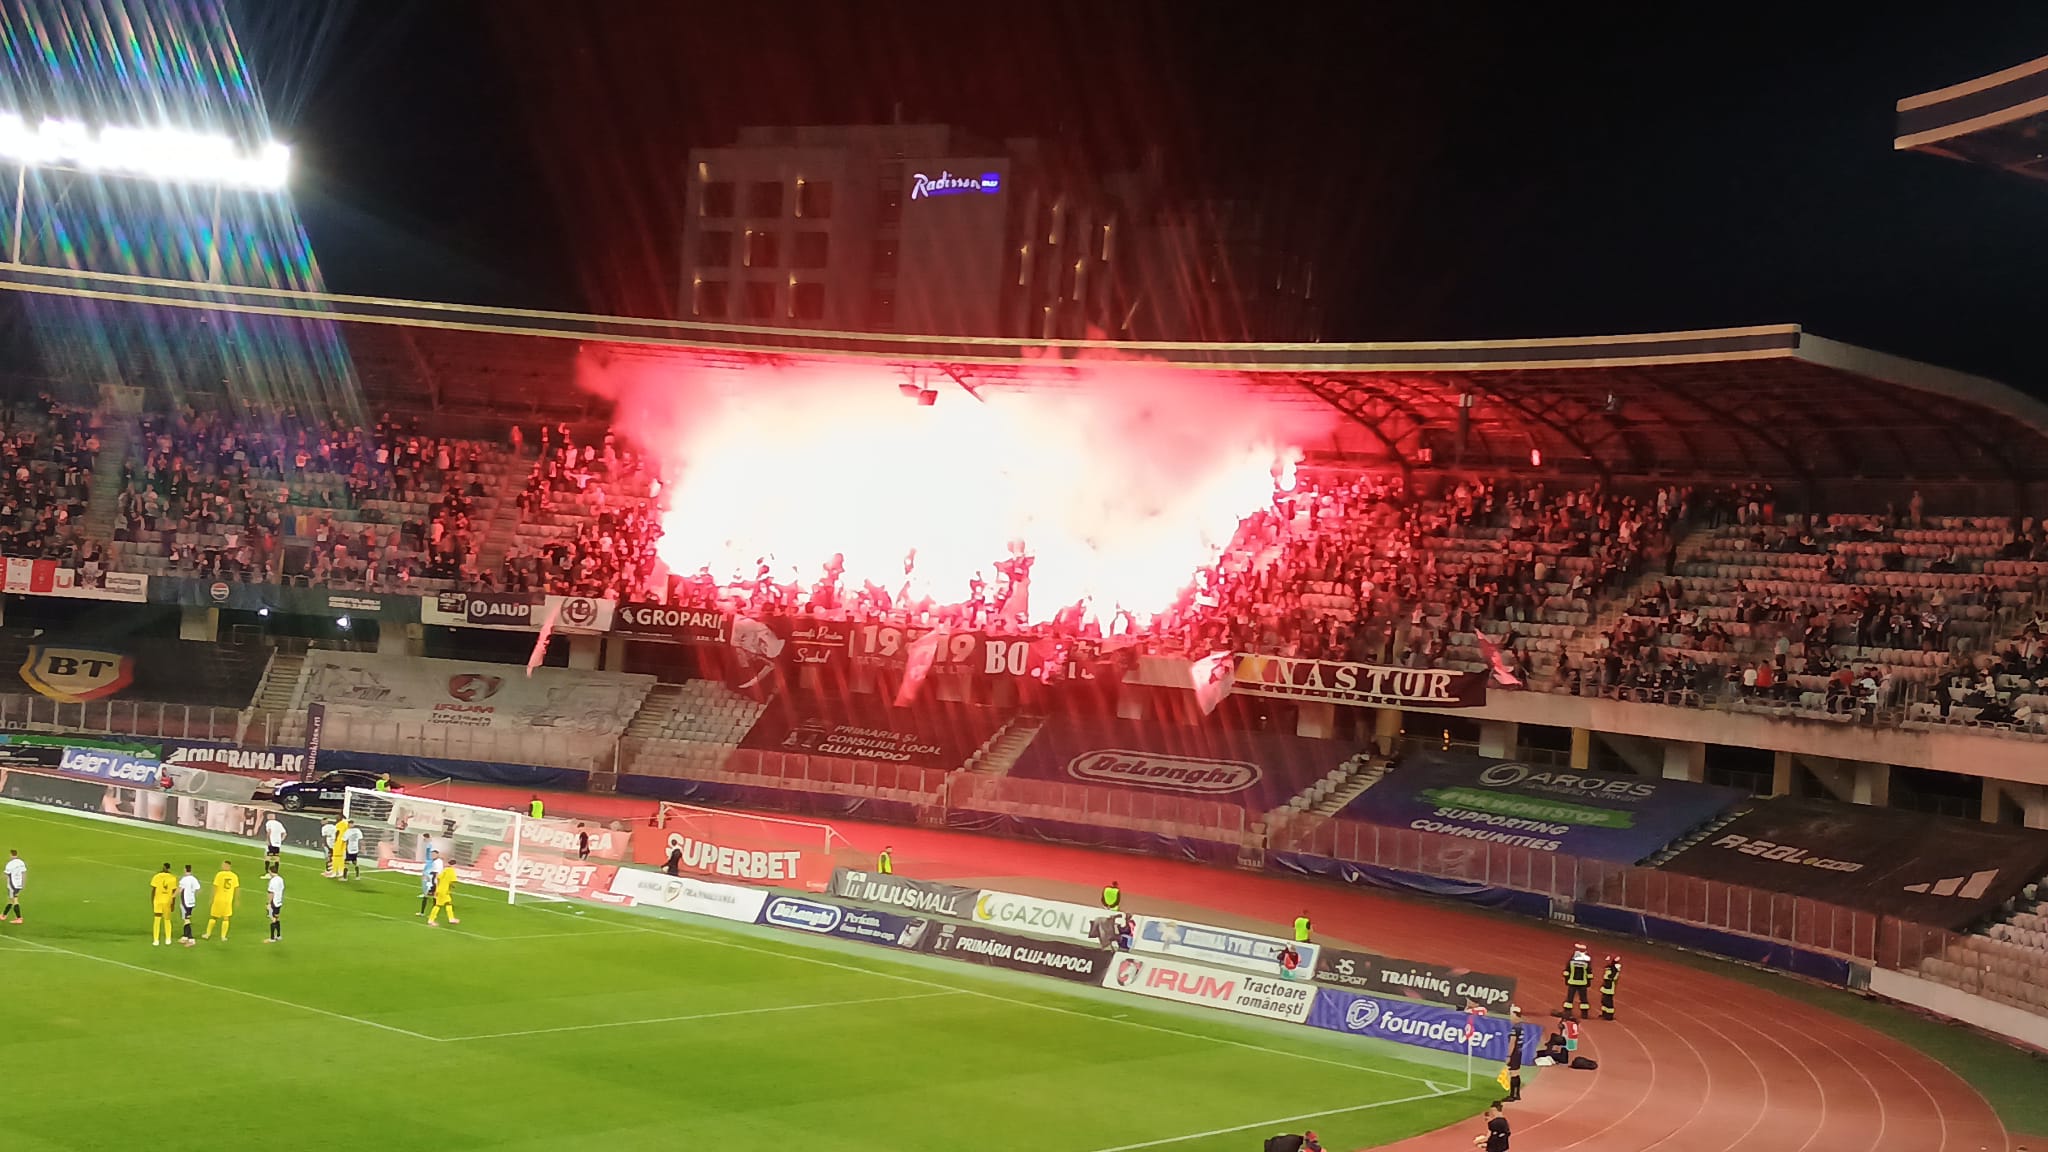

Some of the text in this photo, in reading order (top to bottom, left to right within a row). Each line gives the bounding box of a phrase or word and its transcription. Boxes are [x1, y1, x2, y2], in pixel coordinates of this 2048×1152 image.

[912, 170, 981, 200] Radisson
[488, 602, 530, 617] AIUD
[48, 656, 114, 679] BT
[63, 749, 157, 785] Leier Leier
[1525, 773, 1657, 797] AROBS
[1410, 819, 1562, 851] COMMUNITIES
[1433, 807, 1570, 835] SUPPORTING
[666, 833, 801, 880] SUPERBET
[1001, 904, 1074, 931] GAZON
[956, 935, 1094, 974] PRIMĂRIA CLUJ-NAPOCA
[1145, 967, 1308, 1002] IRUM Tractoare
[1456, 982, 1510, 1006] CAMPS
[1380, 1011, 1495, 1049] foundever
